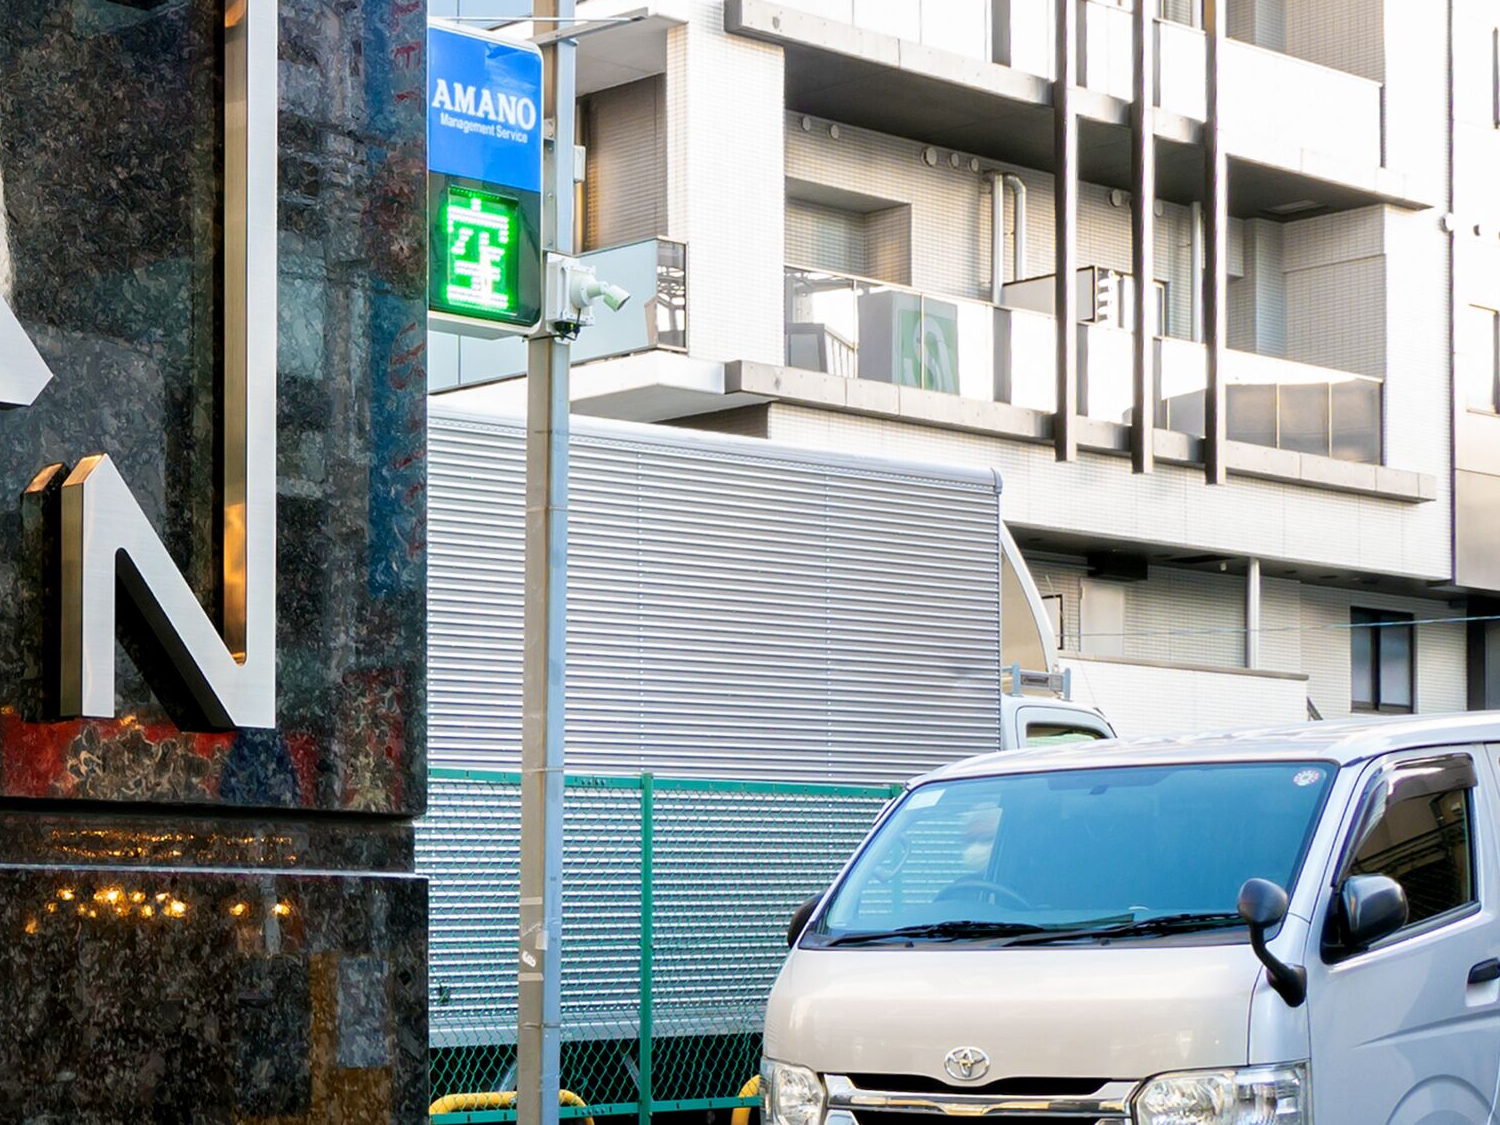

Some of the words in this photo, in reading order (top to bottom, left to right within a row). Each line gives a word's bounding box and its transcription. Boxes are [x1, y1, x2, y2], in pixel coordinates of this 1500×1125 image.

[431, 78, 536, 131] AMANO
[440, 112, 495, 135] Management
[495, 124, 528, 144] Service
[446, 196, 509, 310] 空
